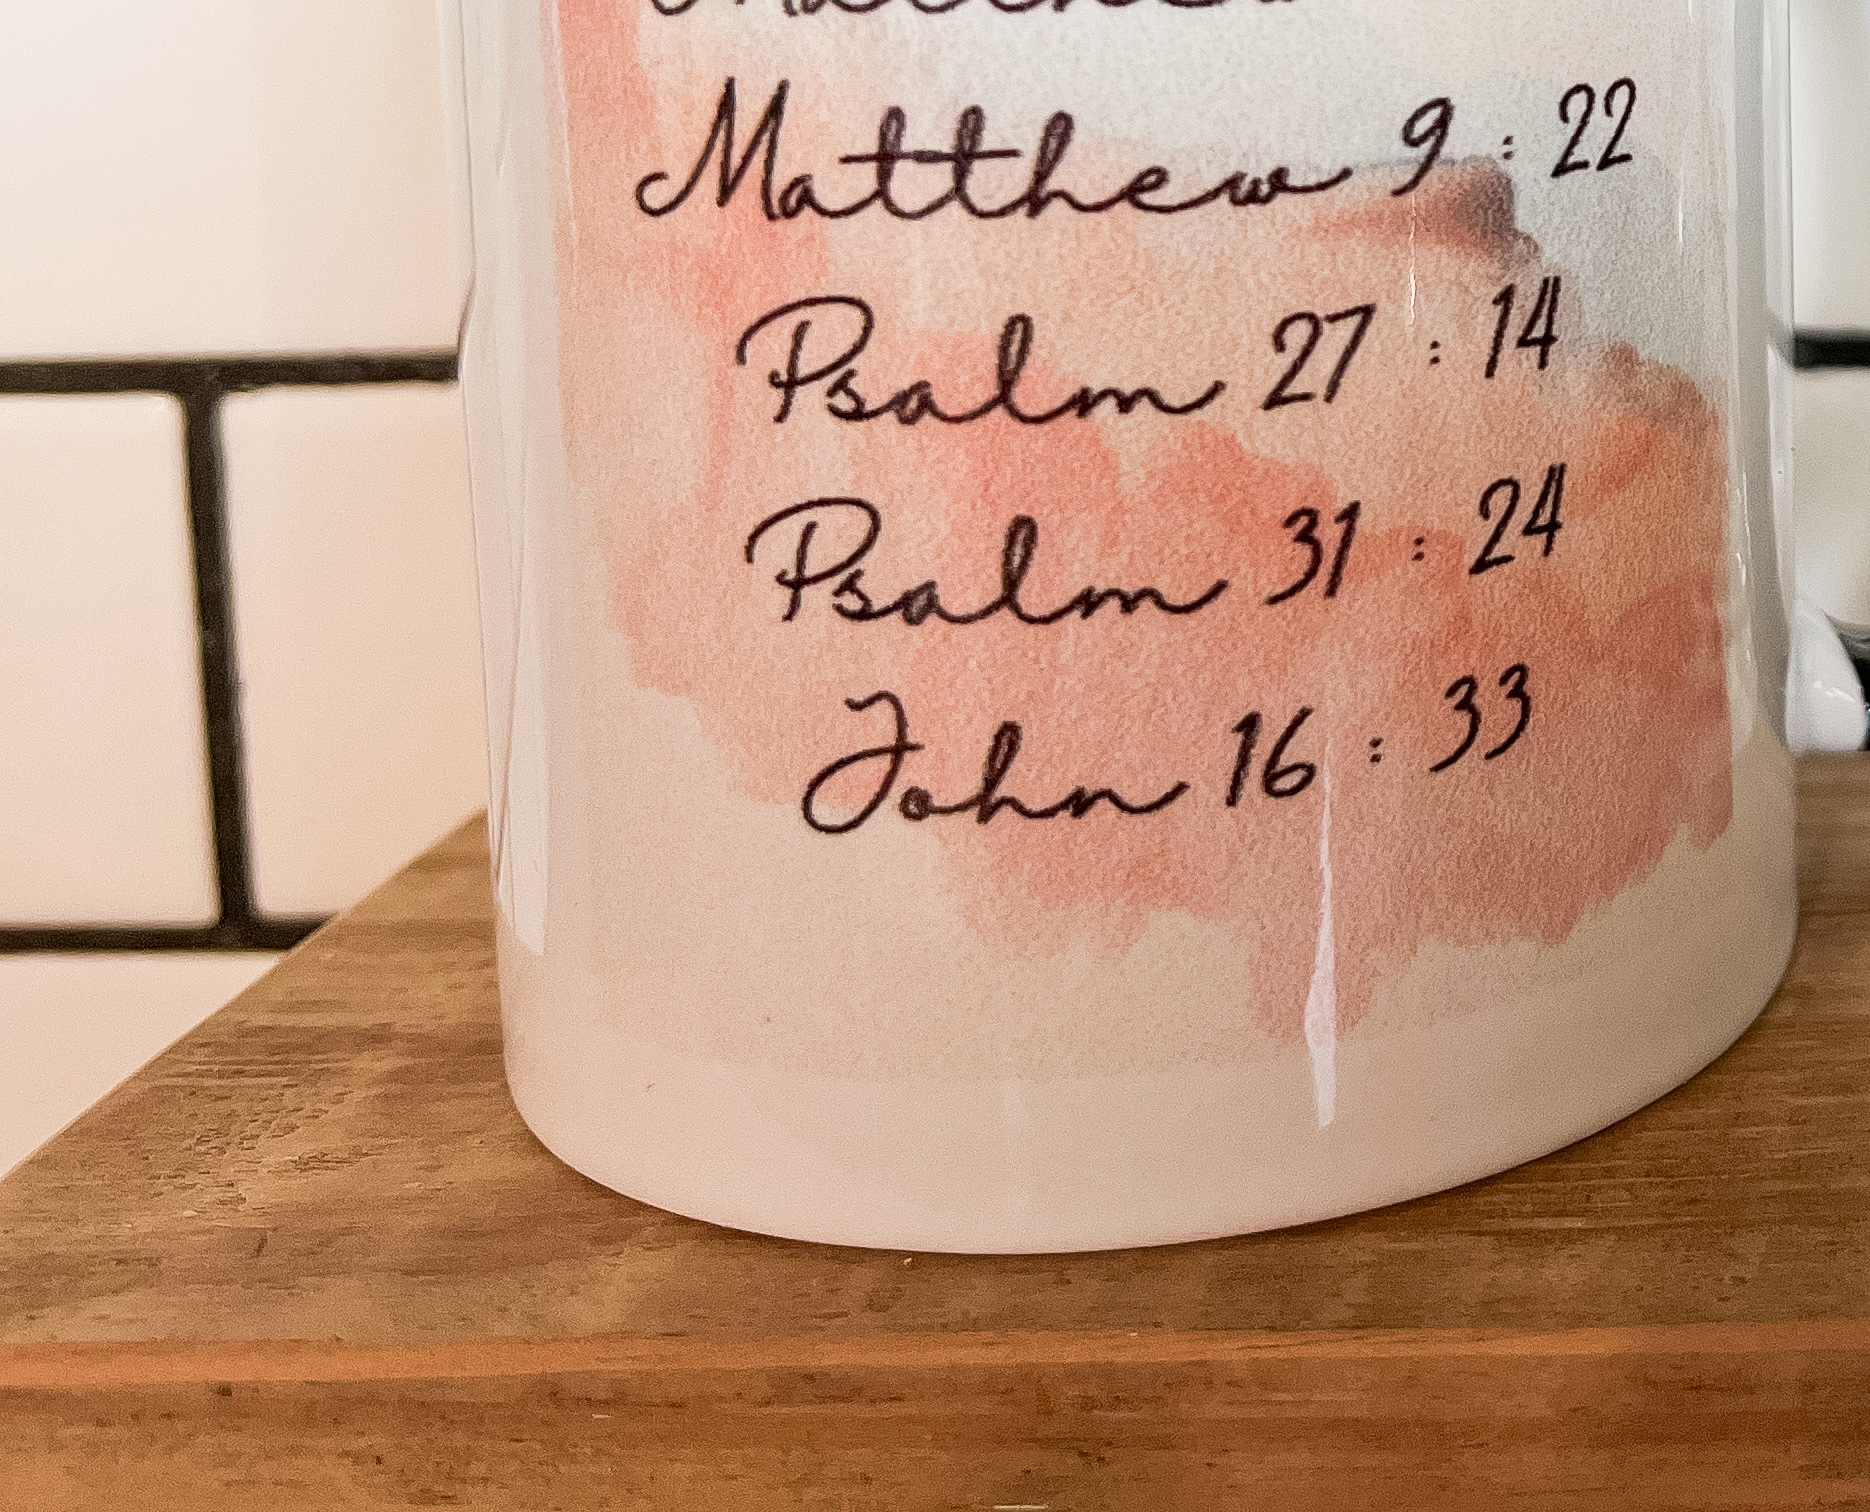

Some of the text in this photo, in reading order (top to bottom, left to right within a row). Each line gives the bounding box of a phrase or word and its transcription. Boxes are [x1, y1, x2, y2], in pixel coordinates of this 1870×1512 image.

[635, 76, 1354, 223] Matthew
[1390, 95, 1456, 199] 9
[1549, 76, 1638, 180] 22
[735, 294, 1227, 427] Psalm
[1260, 302, 1377, 412] 27
[1484, 274, 1562, 381] 14
[744, 496, 1230, 627] Psalm
[1264, 499, 1361, 607] 31
[1467, 461, 1568, 577] 24
[801, 689, 1192, 836] John
[1224, 705, 1318, 809] 16
[1427, 660, 1534, 775] 33
